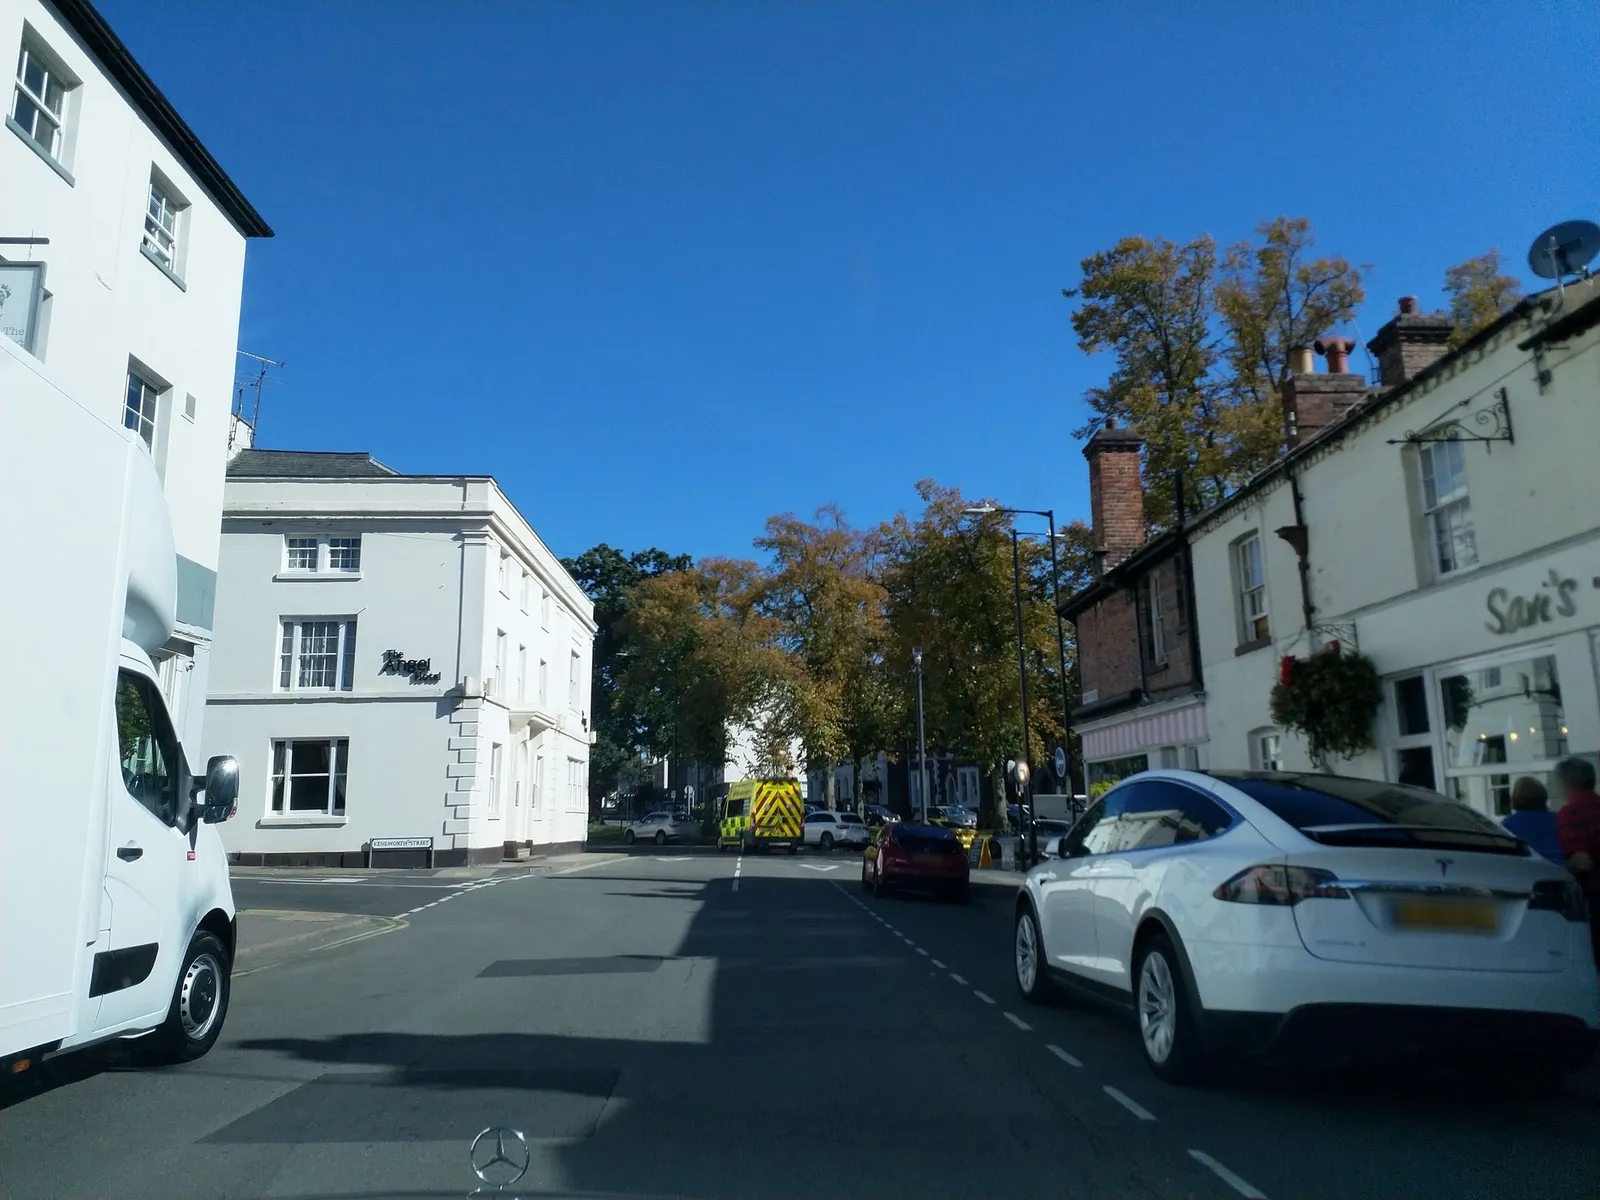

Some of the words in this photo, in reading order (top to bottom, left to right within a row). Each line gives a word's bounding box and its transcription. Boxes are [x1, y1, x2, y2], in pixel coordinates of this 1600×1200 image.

[4, 326, 25, 336] The
[386, 649, 404, 659] The
[383, 658, 431, 673] Angel
[414, 671, 442, 681] Hotel
